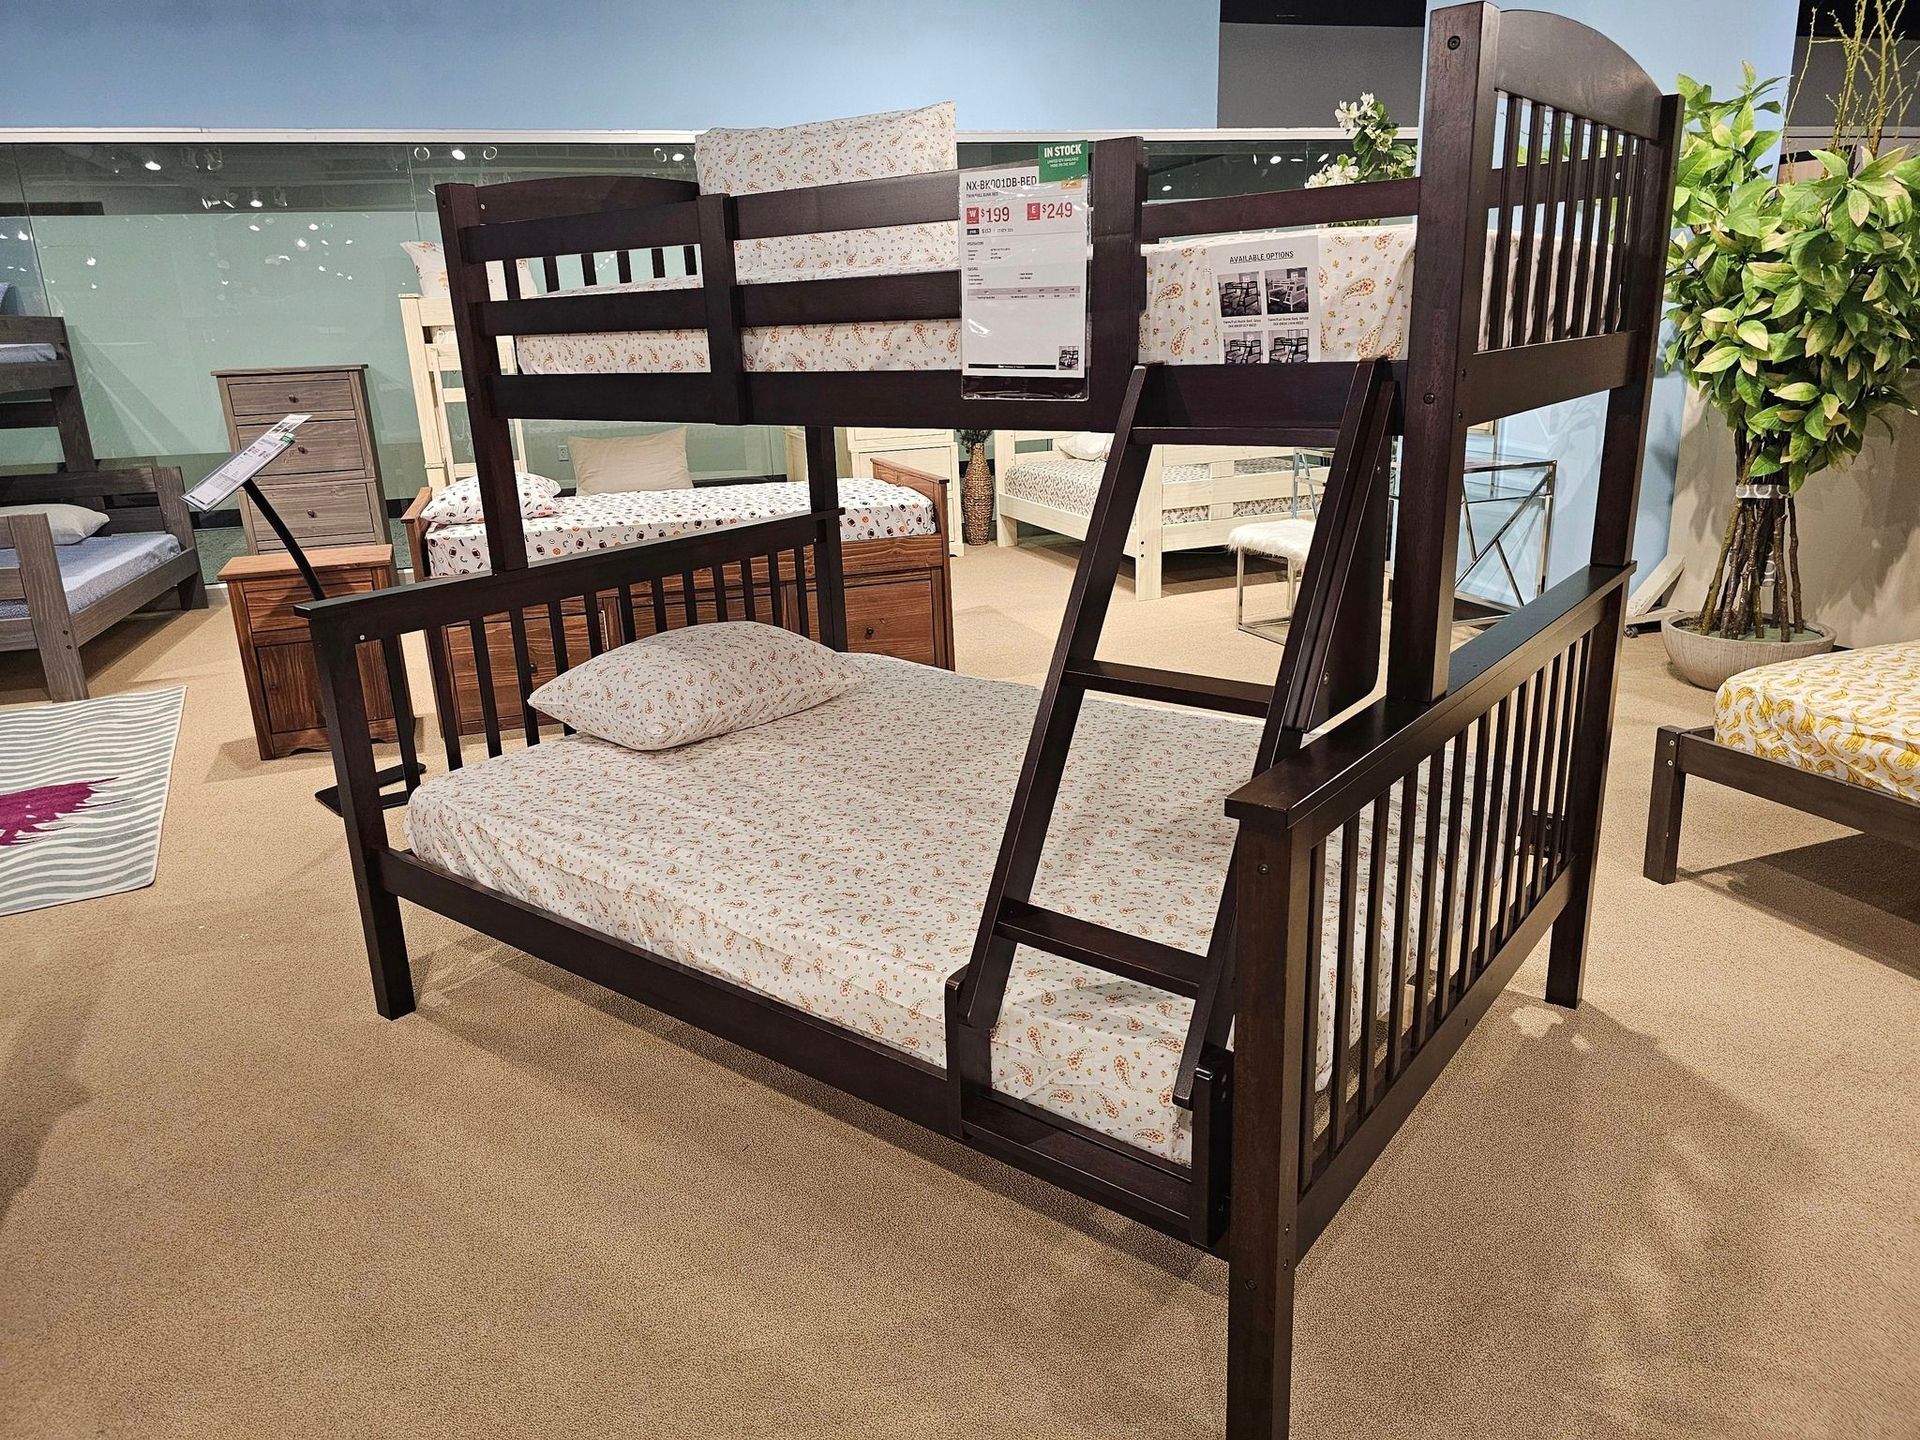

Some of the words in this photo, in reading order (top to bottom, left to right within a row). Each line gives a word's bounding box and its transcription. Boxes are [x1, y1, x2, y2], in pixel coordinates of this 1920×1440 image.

[1044, 147, 1053, 158] IN
[1054, 143, 1082, 157] STOCK
[969, 209, 977, 218] W
[981, 206, 1010, 223] $199
[1031, 205, 1036, 214] E
[1042, 201, 1073, 219] $249
[1229, 253, 1264, 264] AVAILABLE
[1265, 250, 1294, 260] OPTIONS
